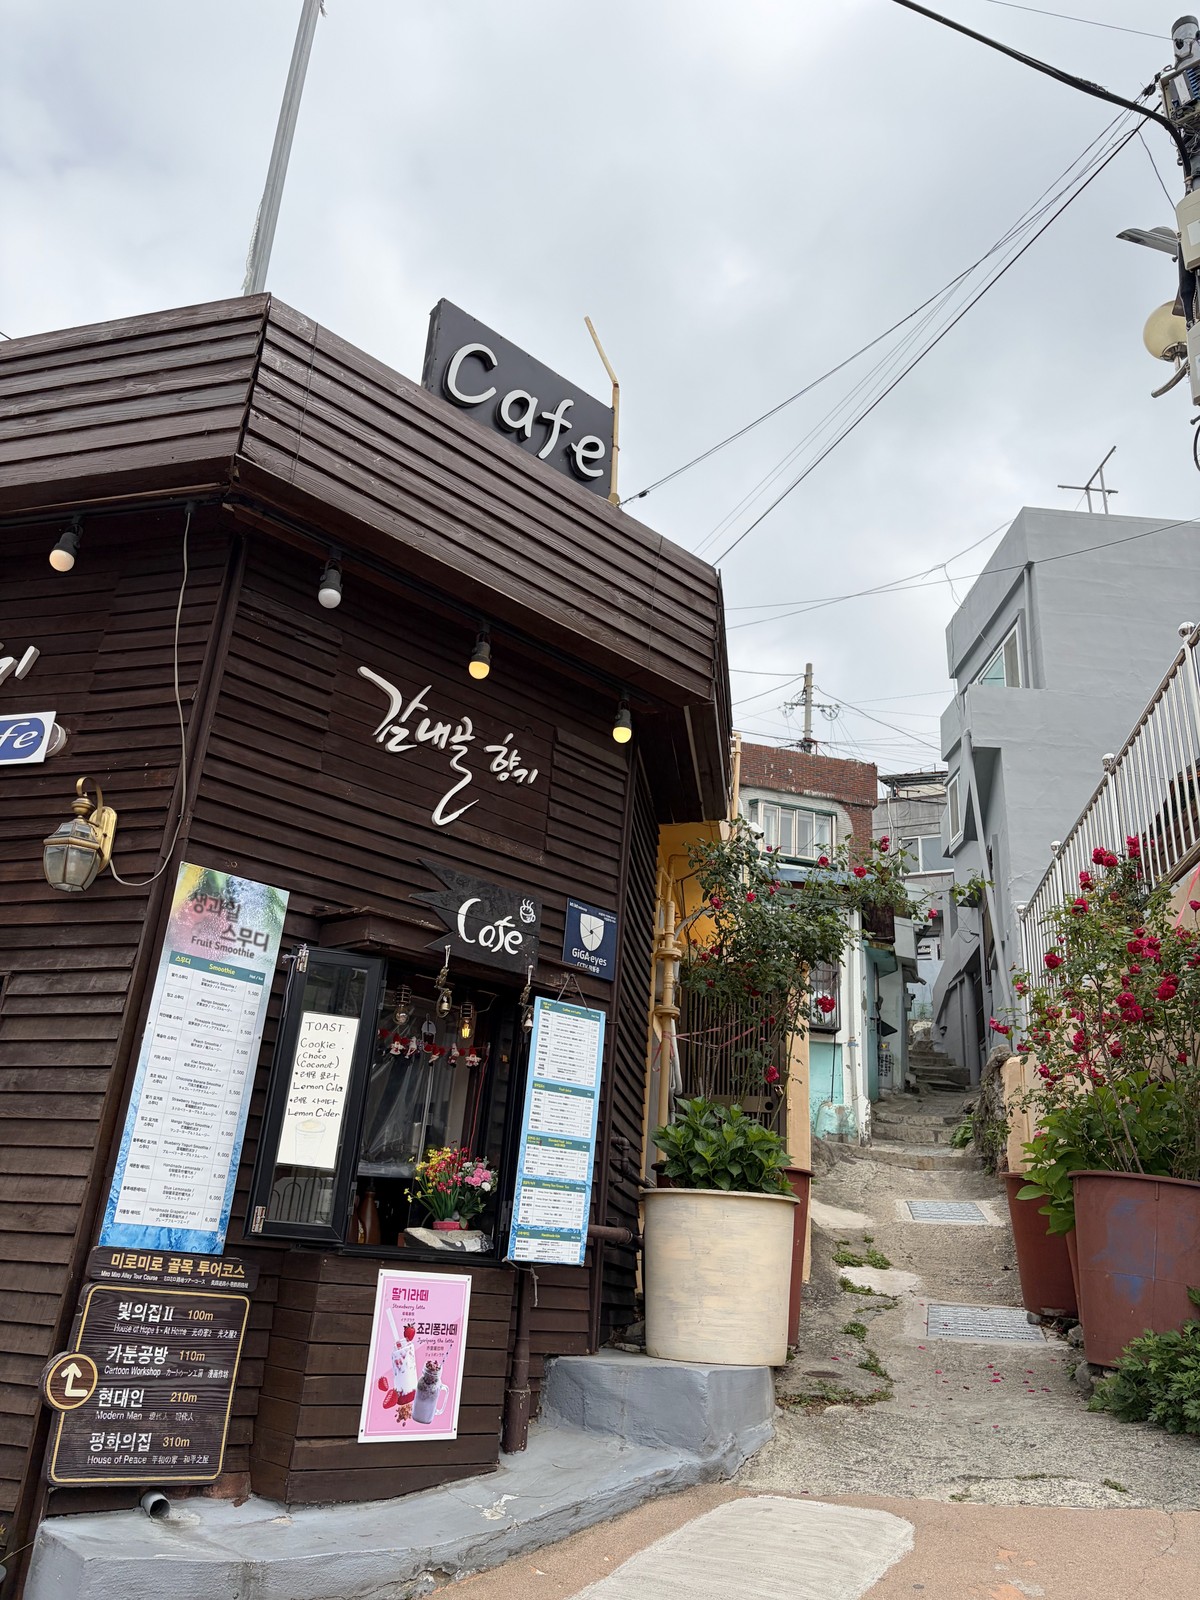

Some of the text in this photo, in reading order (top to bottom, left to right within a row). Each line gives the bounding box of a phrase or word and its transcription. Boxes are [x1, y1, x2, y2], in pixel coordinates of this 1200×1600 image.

[445, 343, 605, 479] Cafe
[483, 732, 539, 784] 향기
[190, 893, 241, 922] 생과일
[457, 897, 523, 955] Cafe
[220, 925, 269, 952] 스무디
[191, 936, 255, 959] Fruit Smoothie
[175, 955, 191, 965] 스무디
[209, 963, 235, 975] Smoothie
[201, 977, 219, 985] Strawberry
[194, 1017, 210, 1025] Pineapple
[293, 1082, 343, 1092] Lemon Cola
[288, 1108, 340, 1117] Lemon Cider
[111, 1252, 245, 1278] 미로미로 골목 투어코스
[392, 1288, 429, 1301] 딸기라떼
[188, 1310, 214, 1321] 100m
[114, 1324, 132, 1333] House
[140, 1326, 154, 1335] Hope
[171, 1327, 187, 1335] Home
[106, 1344, 205, 1364] 카툰공방 110m
[104, 1365, 130, 1375] Cartoon
[131, 1366, 161, 1377] Workshop
[98, 1388, 197, 1408] 현대인 210m
[96, 1410, 124, 1420] Modern
[127, 1411, 142, 1420] Man
[89, 1432, 190, 1453] 평화의집 310m
[87, 1455, 111, 1465] House
[114, 1456, 122, 1464] of
[124, 1455, 147, 1465] Peace
